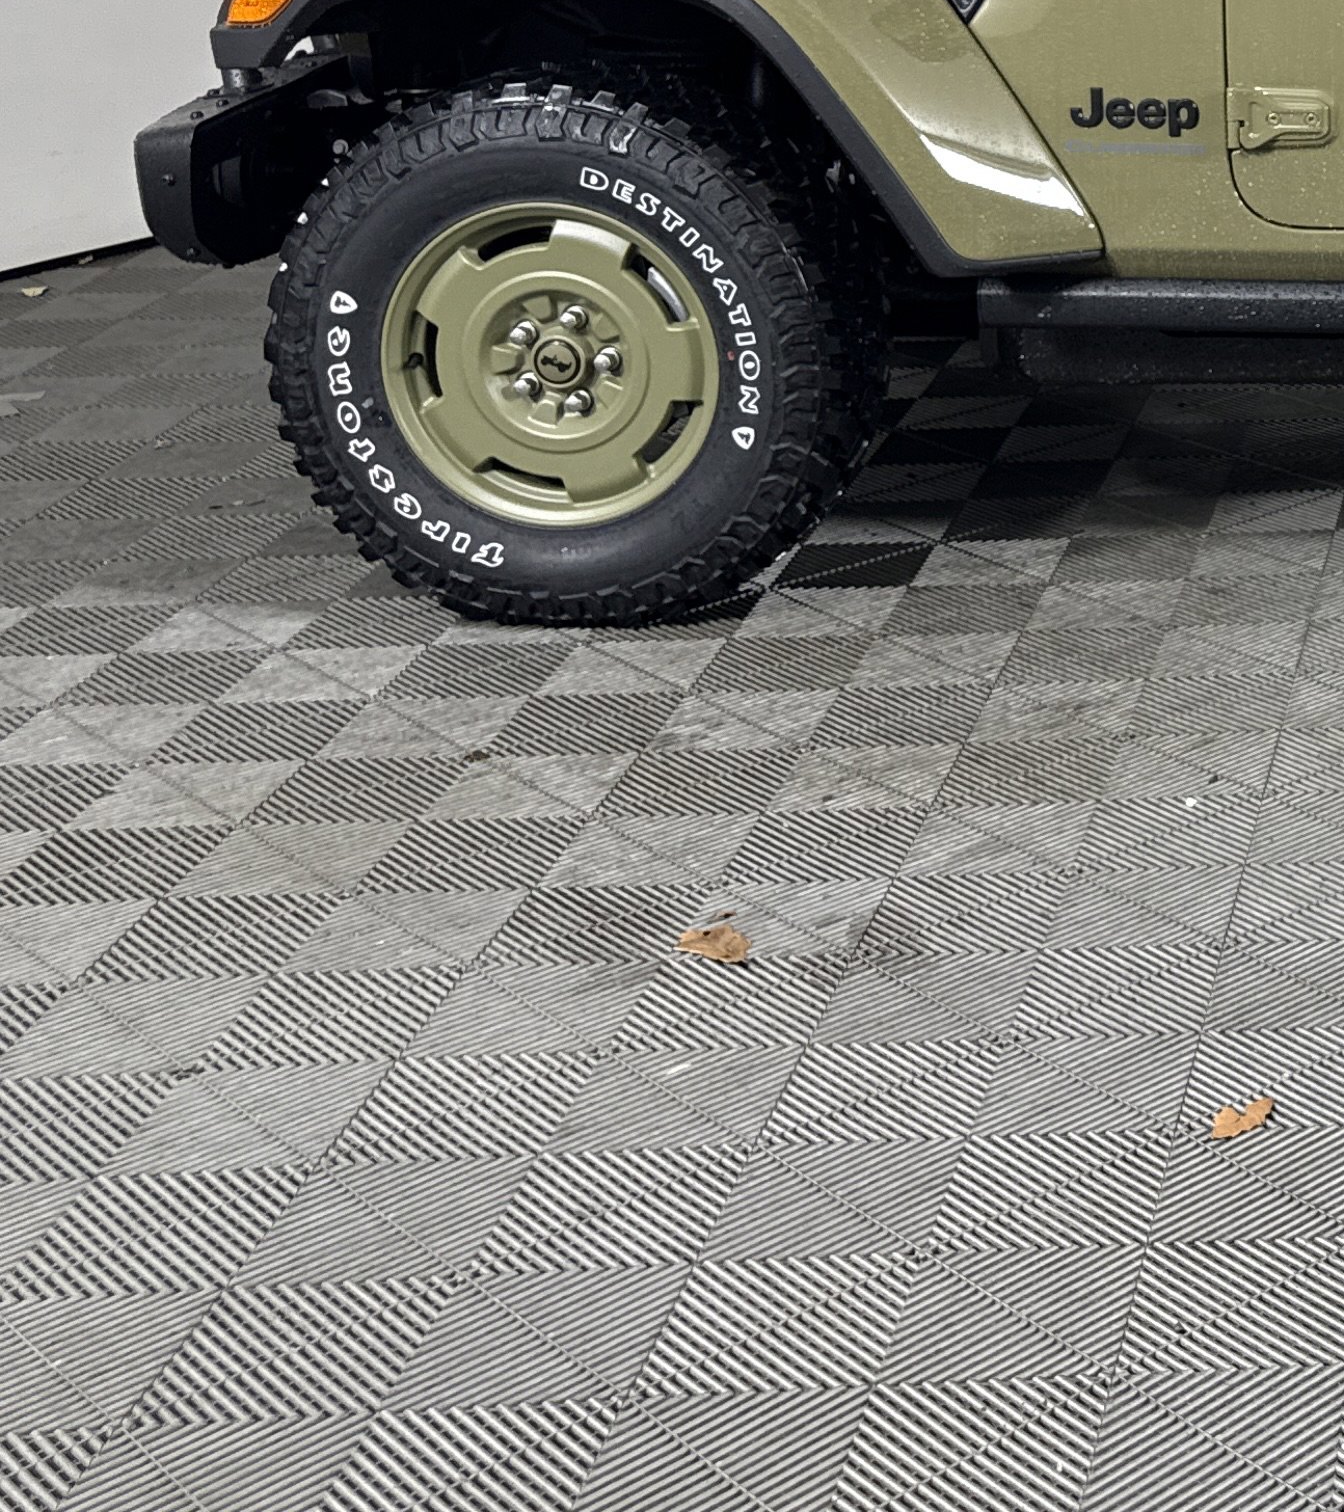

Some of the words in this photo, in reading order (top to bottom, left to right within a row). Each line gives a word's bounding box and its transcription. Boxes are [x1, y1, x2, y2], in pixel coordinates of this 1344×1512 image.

[1070, 87, 1200, 137] Jeep
[579, 166, 763, 415] DESTINATION
[327, 326, 505, 568] Firestone
